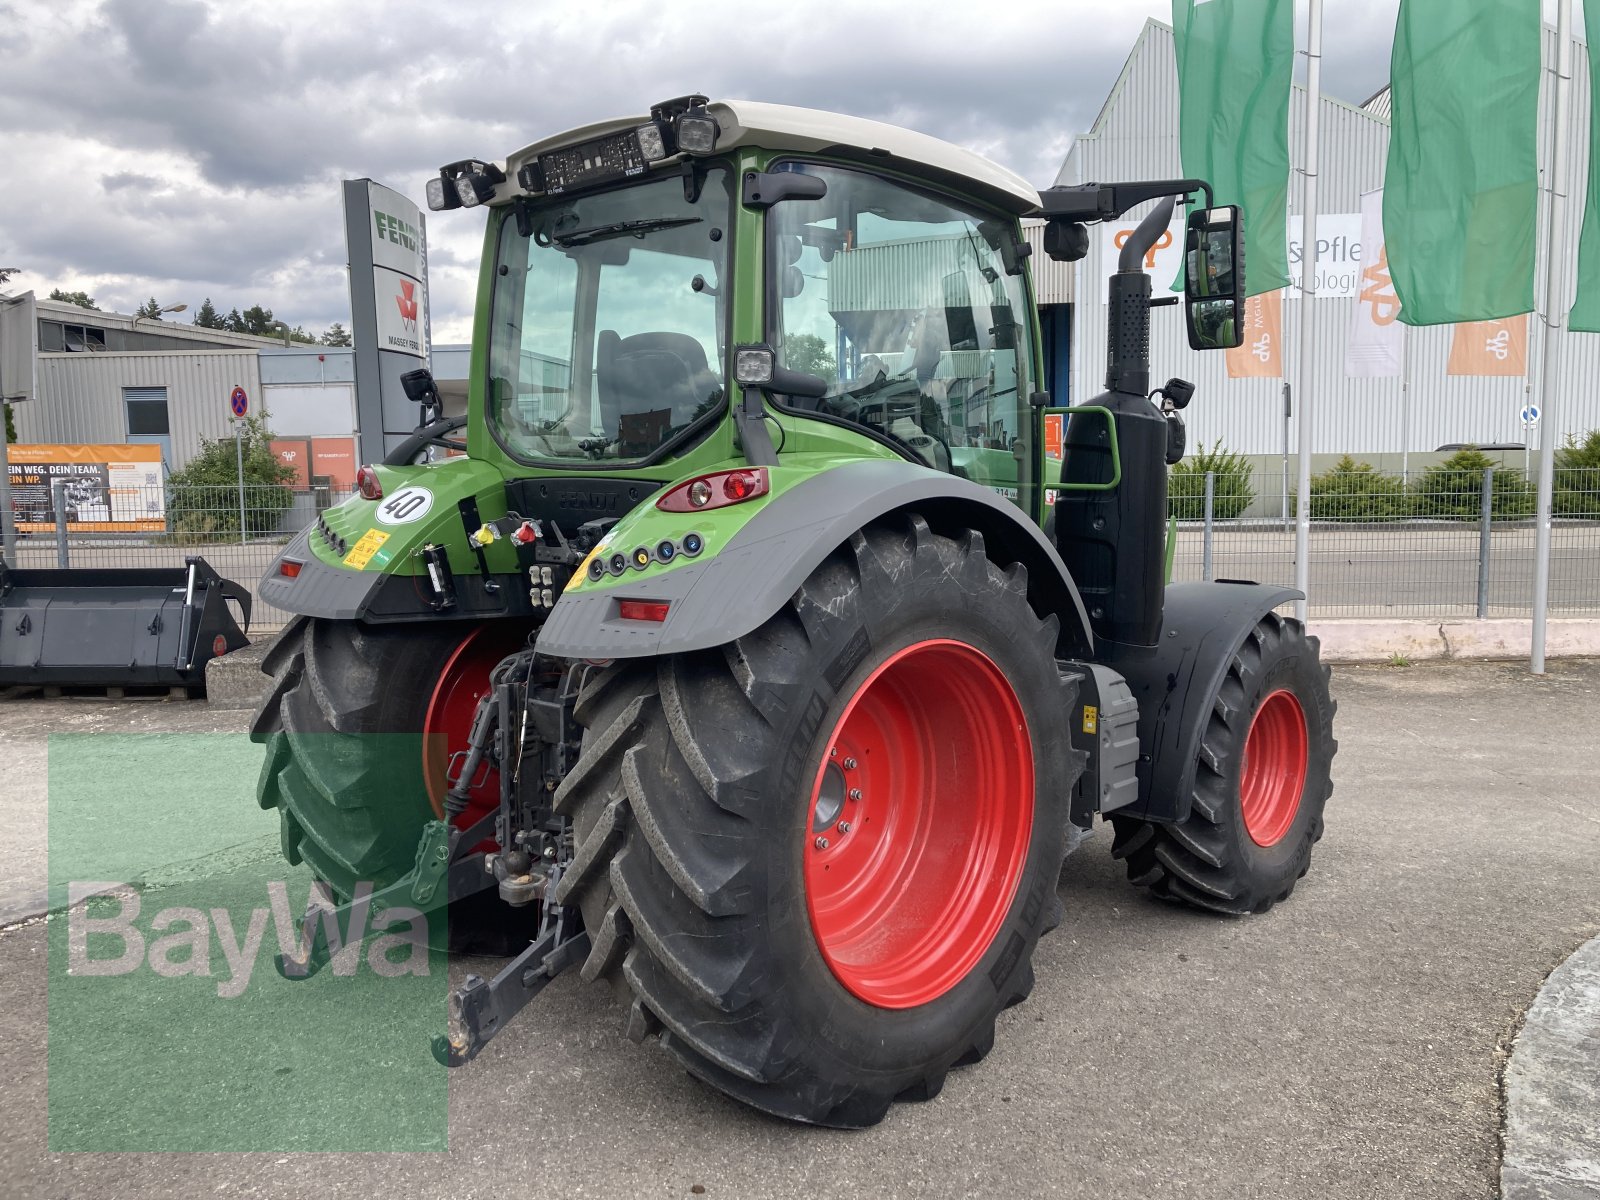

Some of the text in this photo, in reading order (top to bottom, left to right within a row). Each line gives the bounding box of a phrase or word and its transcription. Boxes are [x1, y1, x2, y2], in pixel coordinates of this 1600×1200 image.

[388, 335, 408, 348] MASSEY
[24, 465, 47, 474] WEG.
[49, 465, 71, 474] DEIN
[73, 465, 101, 474] TEAM.
[383, 490, 426, 519] 40
[559, 491, 618, 512] FENDT
